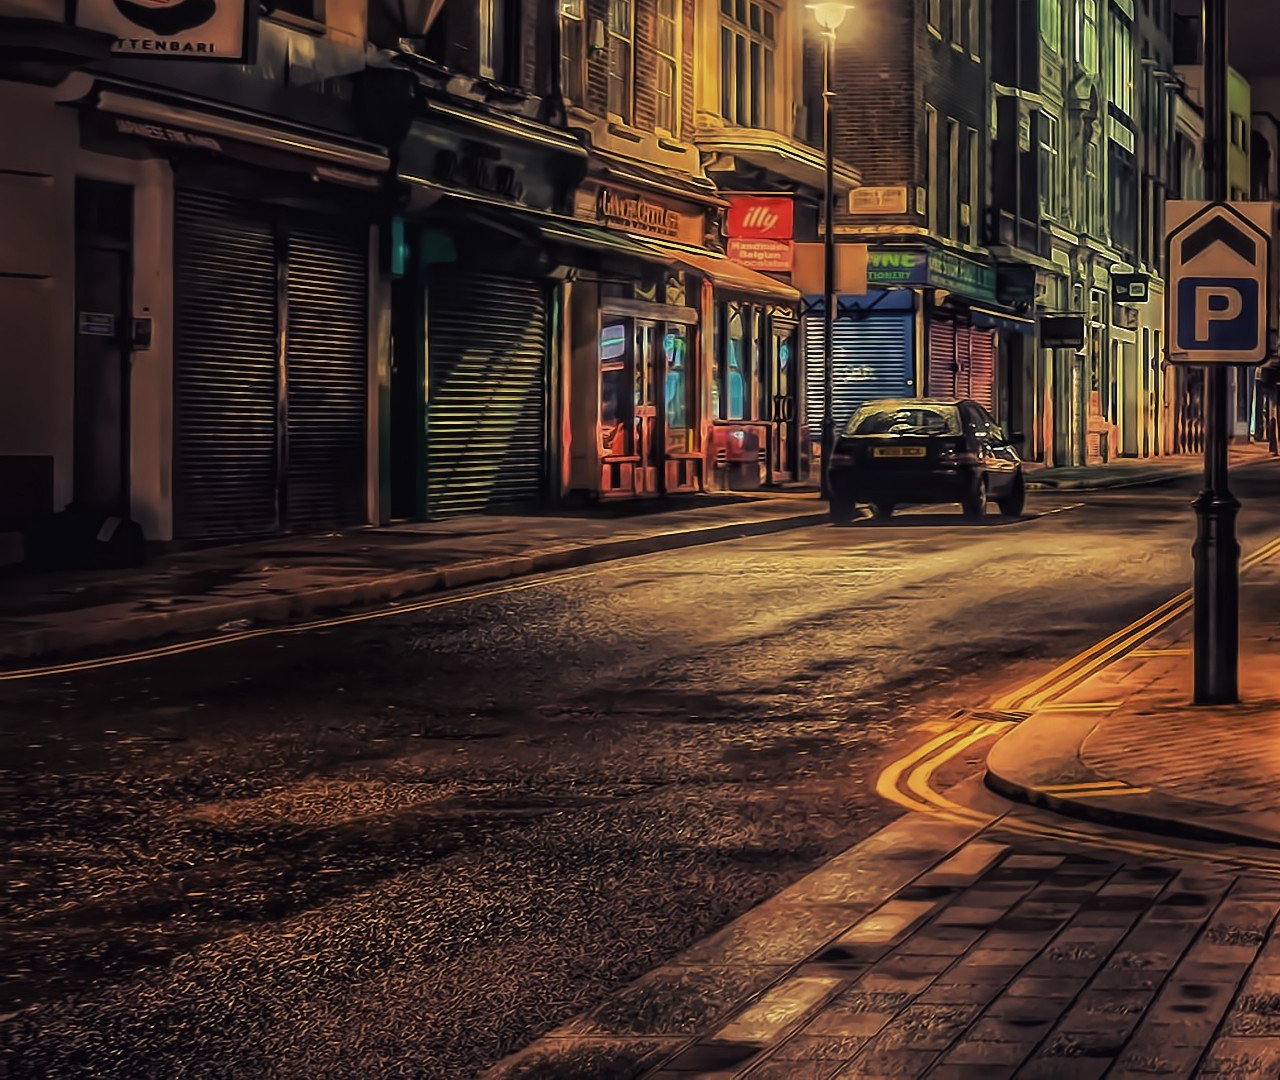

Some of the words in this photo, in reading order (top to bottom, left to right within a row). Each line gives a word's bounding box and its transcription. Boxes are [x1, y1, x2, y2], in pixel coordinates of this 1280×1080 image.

[116, 38, 216, 53] TTENBARI
[742, 206, 779, 233] illy
[1195, 286, 1243, 342] P
